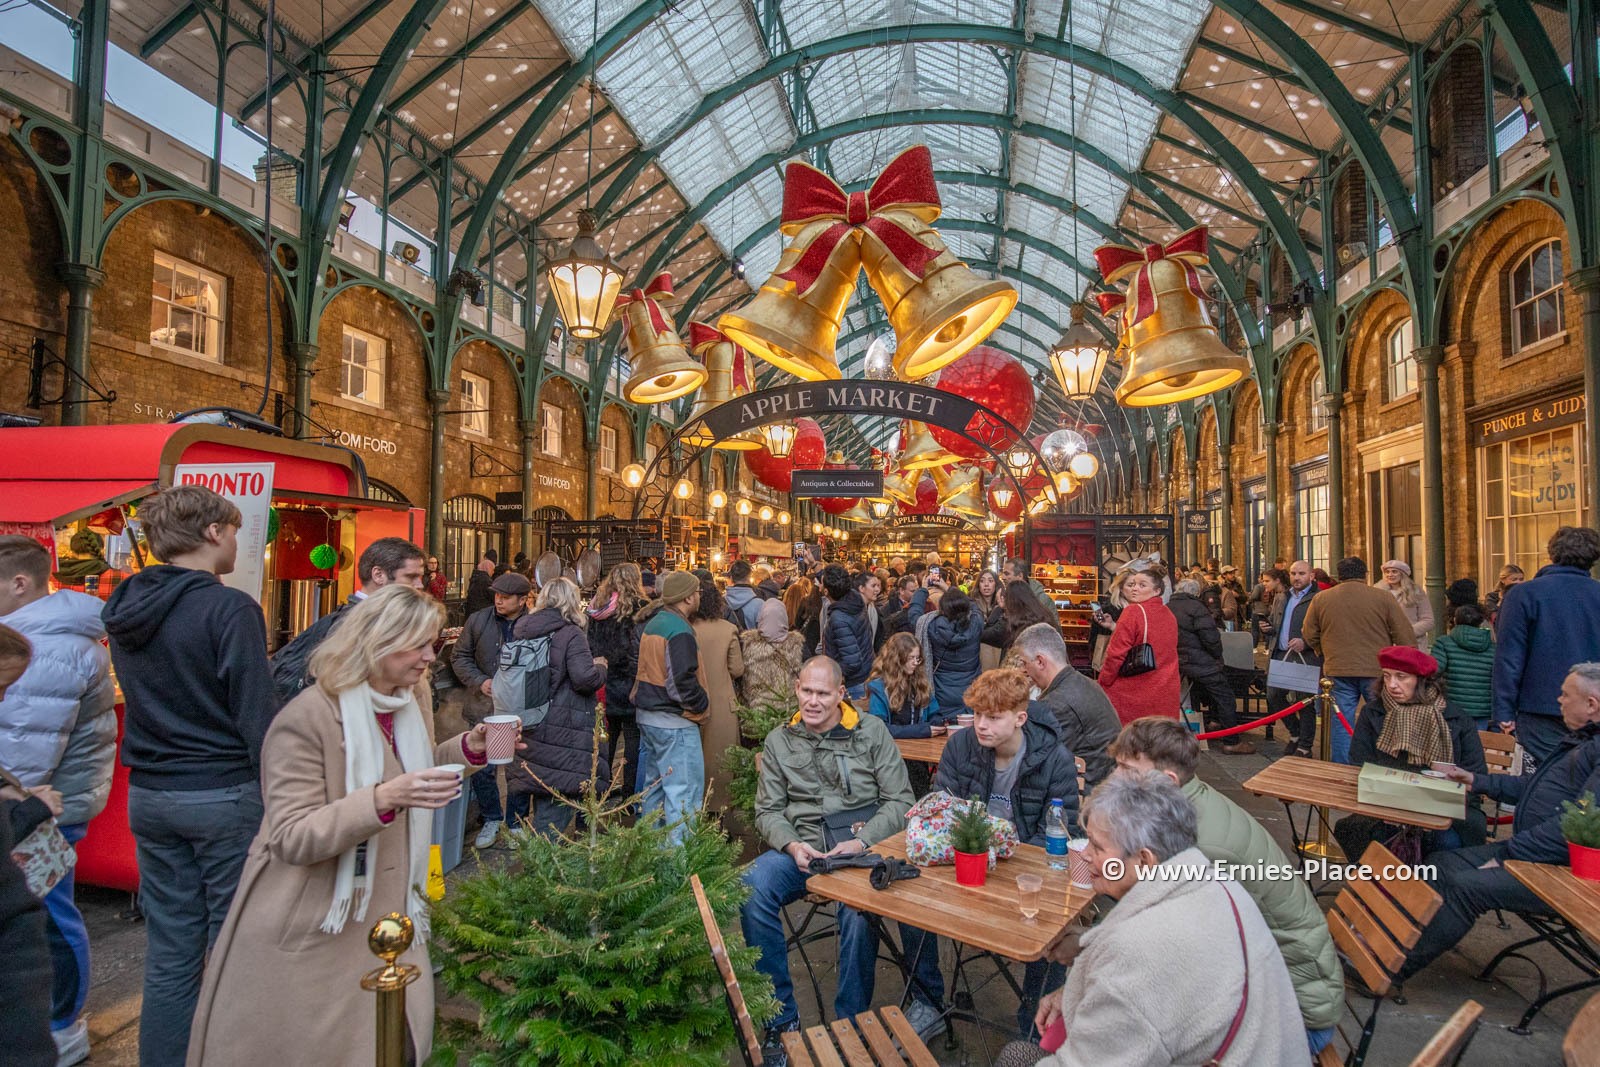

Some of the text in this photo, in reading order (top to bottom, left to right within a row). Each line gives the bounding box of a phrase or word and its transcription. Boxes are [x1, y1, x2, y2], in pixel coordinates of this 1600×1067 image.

[740, 386, 943, 423] APPLE MARKET
[1482, 394, 1587, 437] PUNCH & JUDY
[331, 428, 397, 455] TOM FORD
[538, 474, 571, 490] TOM FORD
[800, 480, 829, 488] Antiques
[836, 479, 874, 487] Collectables
[893, 515, 960, 527] APPLE MARKET
